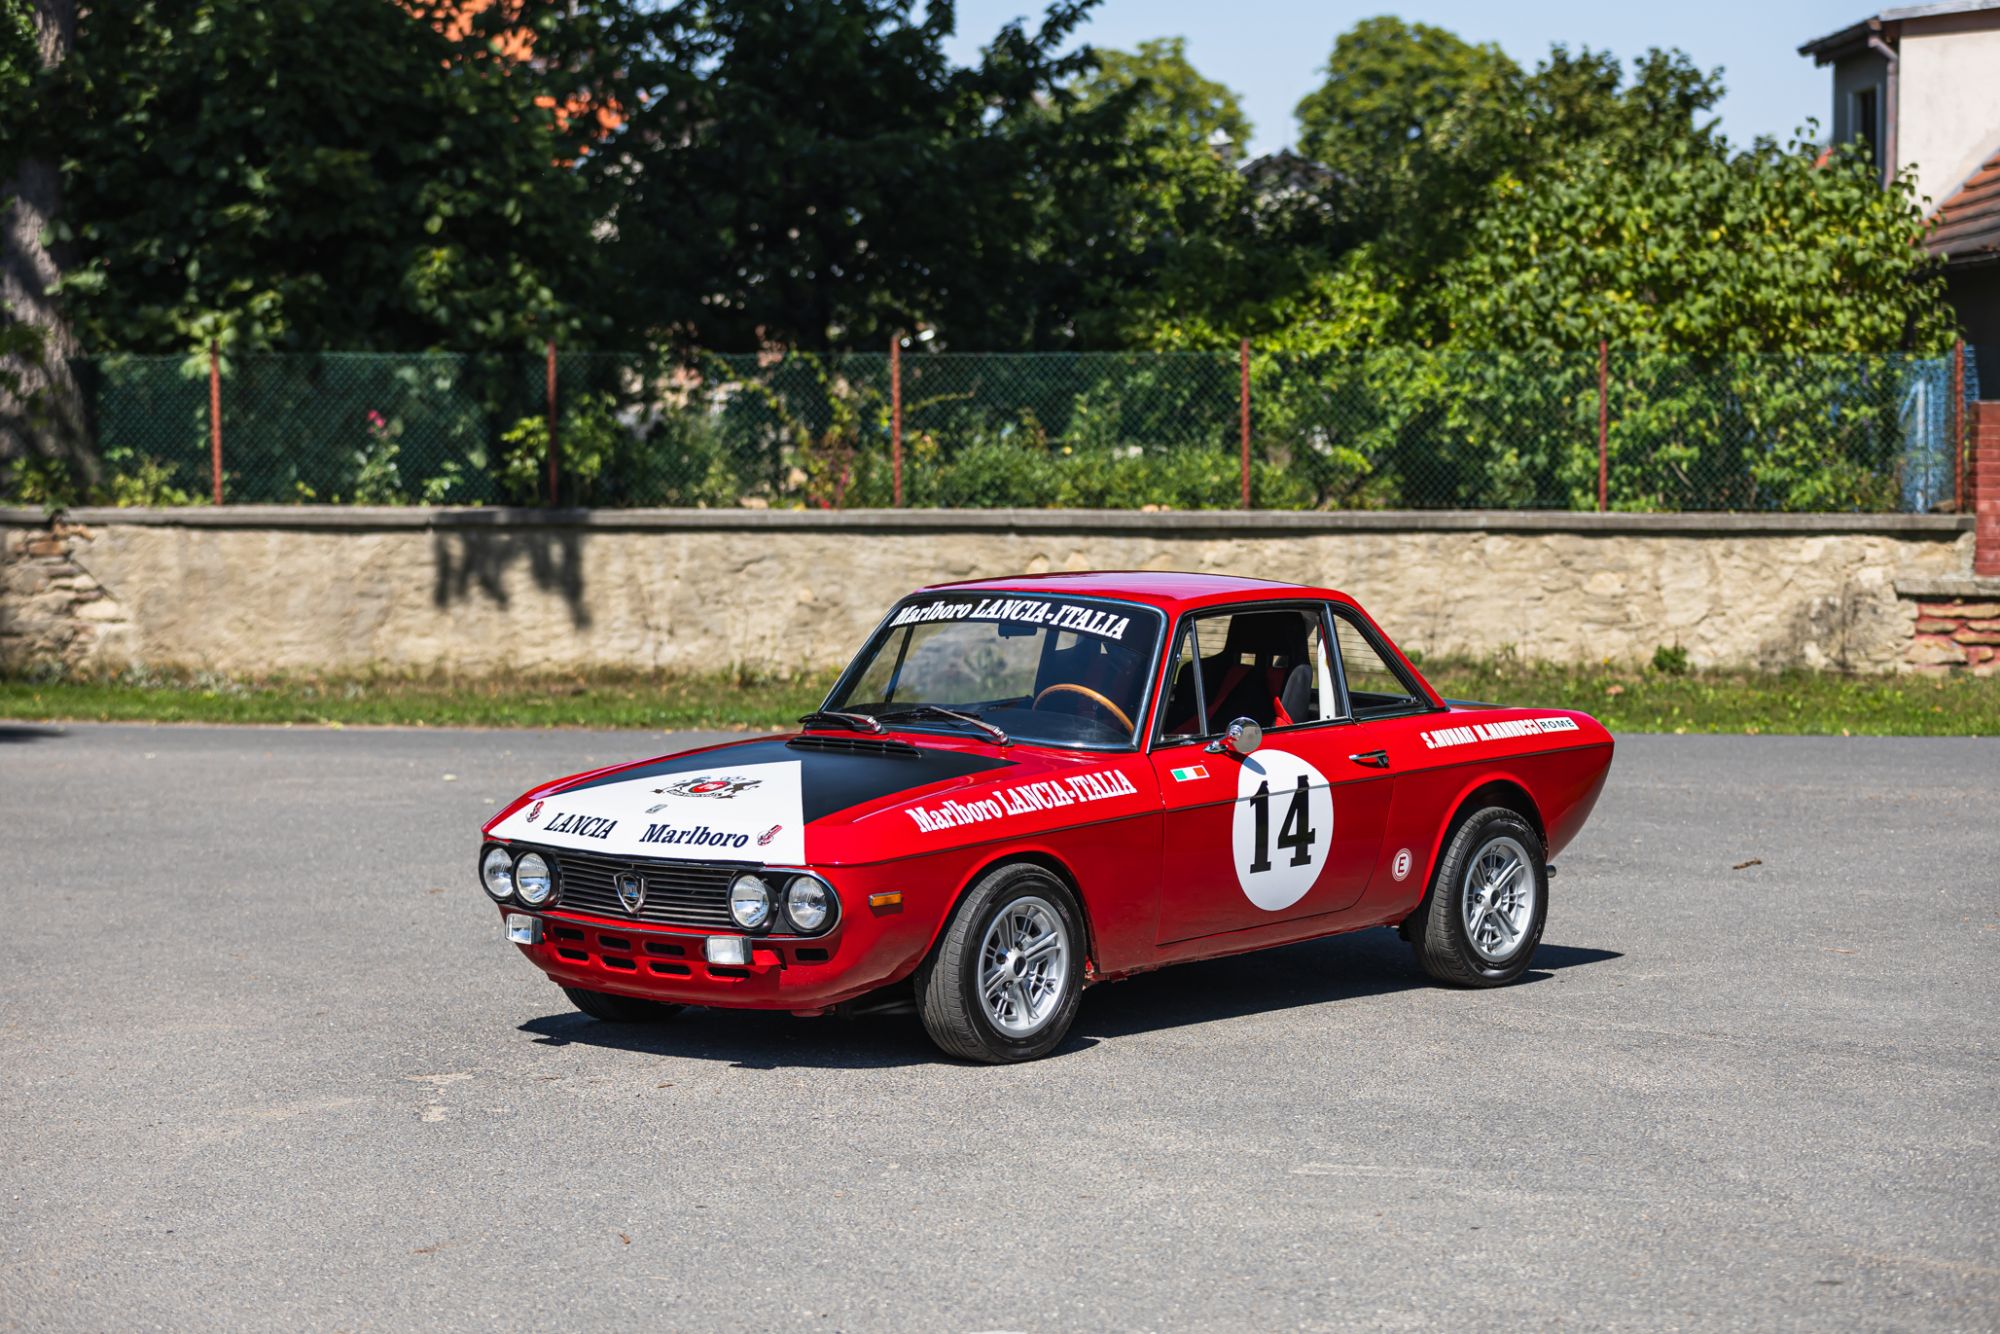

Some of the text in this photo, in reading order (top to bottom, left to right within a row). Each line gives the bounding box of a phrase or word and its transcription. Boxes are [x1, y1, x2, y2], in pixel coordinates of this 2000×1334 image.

[889, 598, 1131, 640] Marlboro LANCIA-ITALIA
[1539, 718, 1575, 730] ROME
[905, 769, 1138, 833] Marlboro LANCIA-ITALIA
[543, 812, 618, 839] LANCIA
[638, 823, 750, 849] Marlboro
[1250, 774, 1316, 874] 14
[1397, 856, 1407, 874] E
